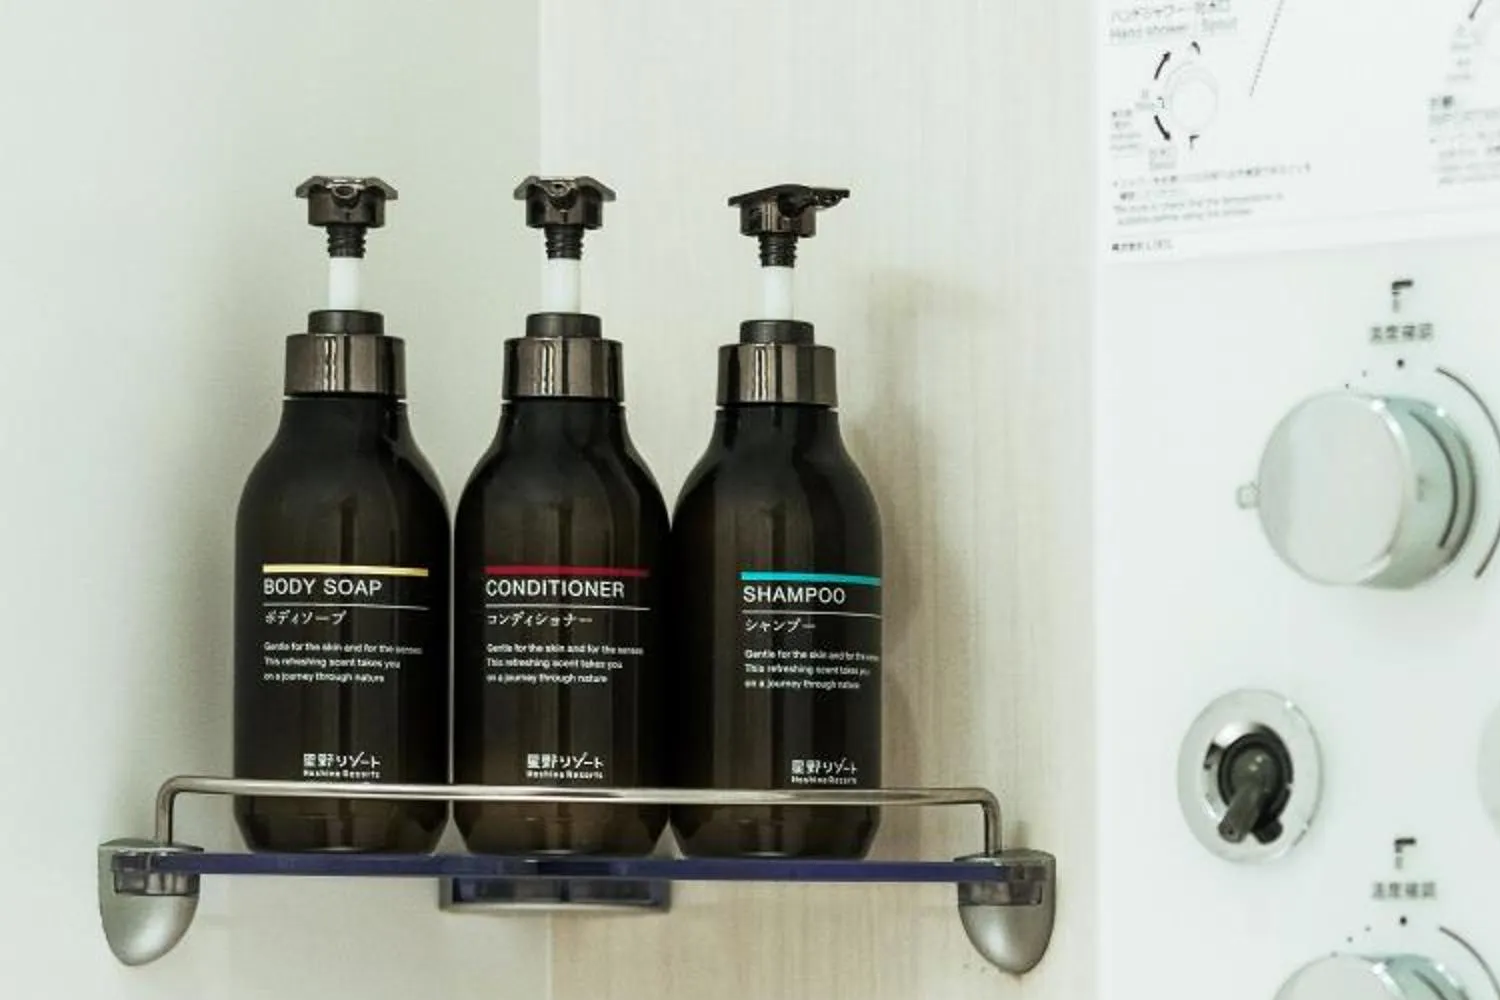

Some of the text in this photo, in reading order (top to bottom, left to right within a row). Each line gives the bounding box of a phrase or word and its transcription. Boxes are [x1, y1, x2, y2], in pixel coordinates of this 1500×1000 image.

[263, 578, 383, 596] BODY SOAP
[486, 579, 625, 598] CONDITIONER
[743, 585, 846, 604] SHAMPOO
[265, 609, 347, 625] ボディソープ
[487, 610, 593, 627] コンディショナー
[745, 617, 816, 633] シャンプー
[291, 642, 302, 652] for
[305, 642, 320, 652] the
[364, 644, 377, 653] for
[380, 645, 393, 654] the
[514, 644, 526, 653] for
[528, 644, 542, 653] the
[588, 644, 600, 654] for
[602, 645, 616, 654] the
[264, 656, 280, 666] This
[384, 660, 400, 670] you
[487, 658, 504, 668] This
[608, 661, 623, 670] you
[316, 672, 352, 683] through
[539, 673, 576, 684] through
